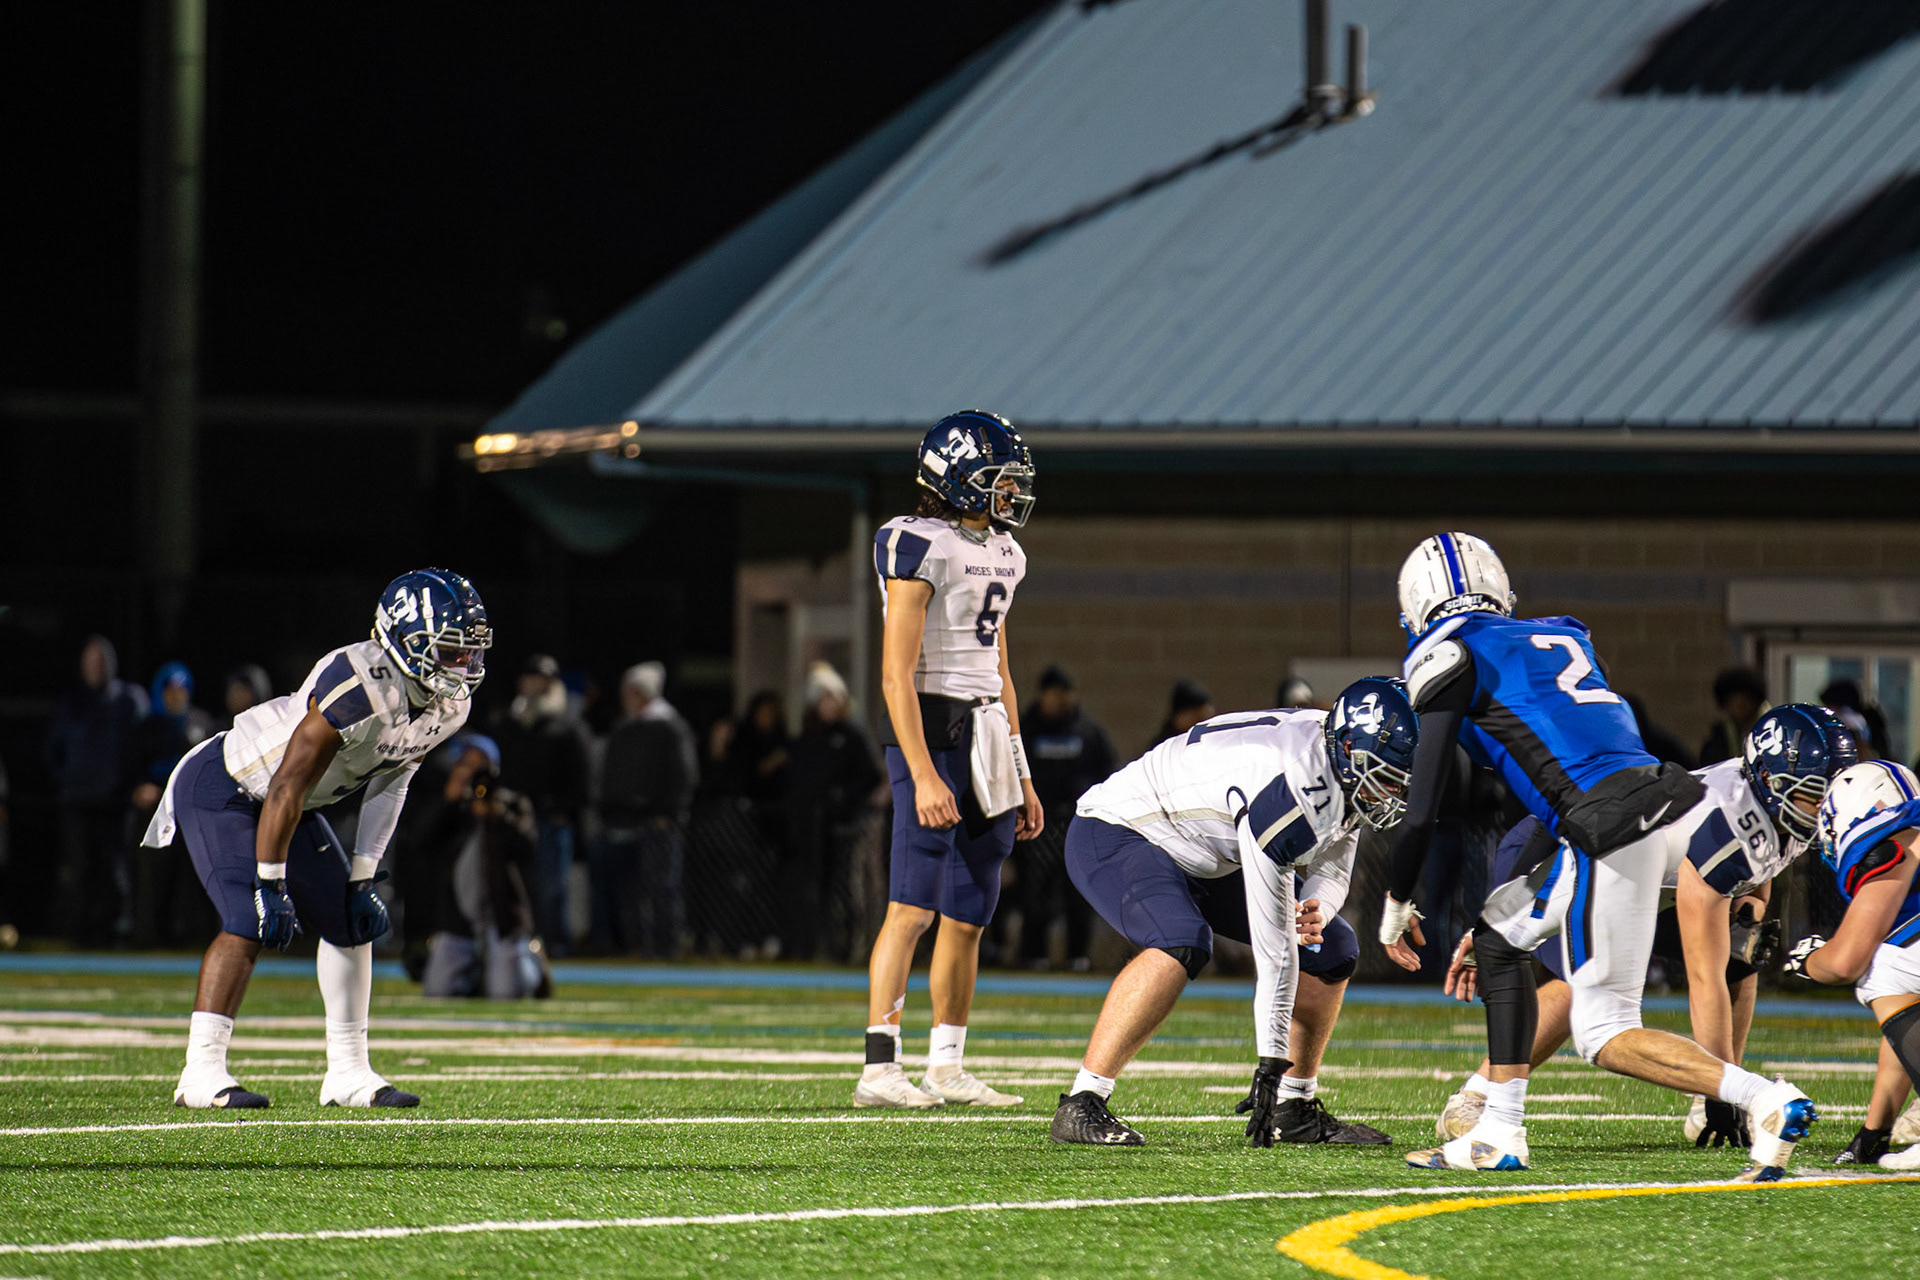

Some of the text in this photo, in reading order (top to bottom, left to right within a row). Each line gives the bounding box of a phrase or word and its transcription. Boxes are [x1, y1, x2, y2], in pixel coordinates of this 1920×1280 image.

[964, 564, 1016, 578] MOSES BROWN
[975, 581, 1008, 647] 6
[368, 665, 392, 680] 5
[1529, 633, 1622, 706] 2
[1301, 774, 1332, 816] 71
[1737, 809, 1768, 850] 56
